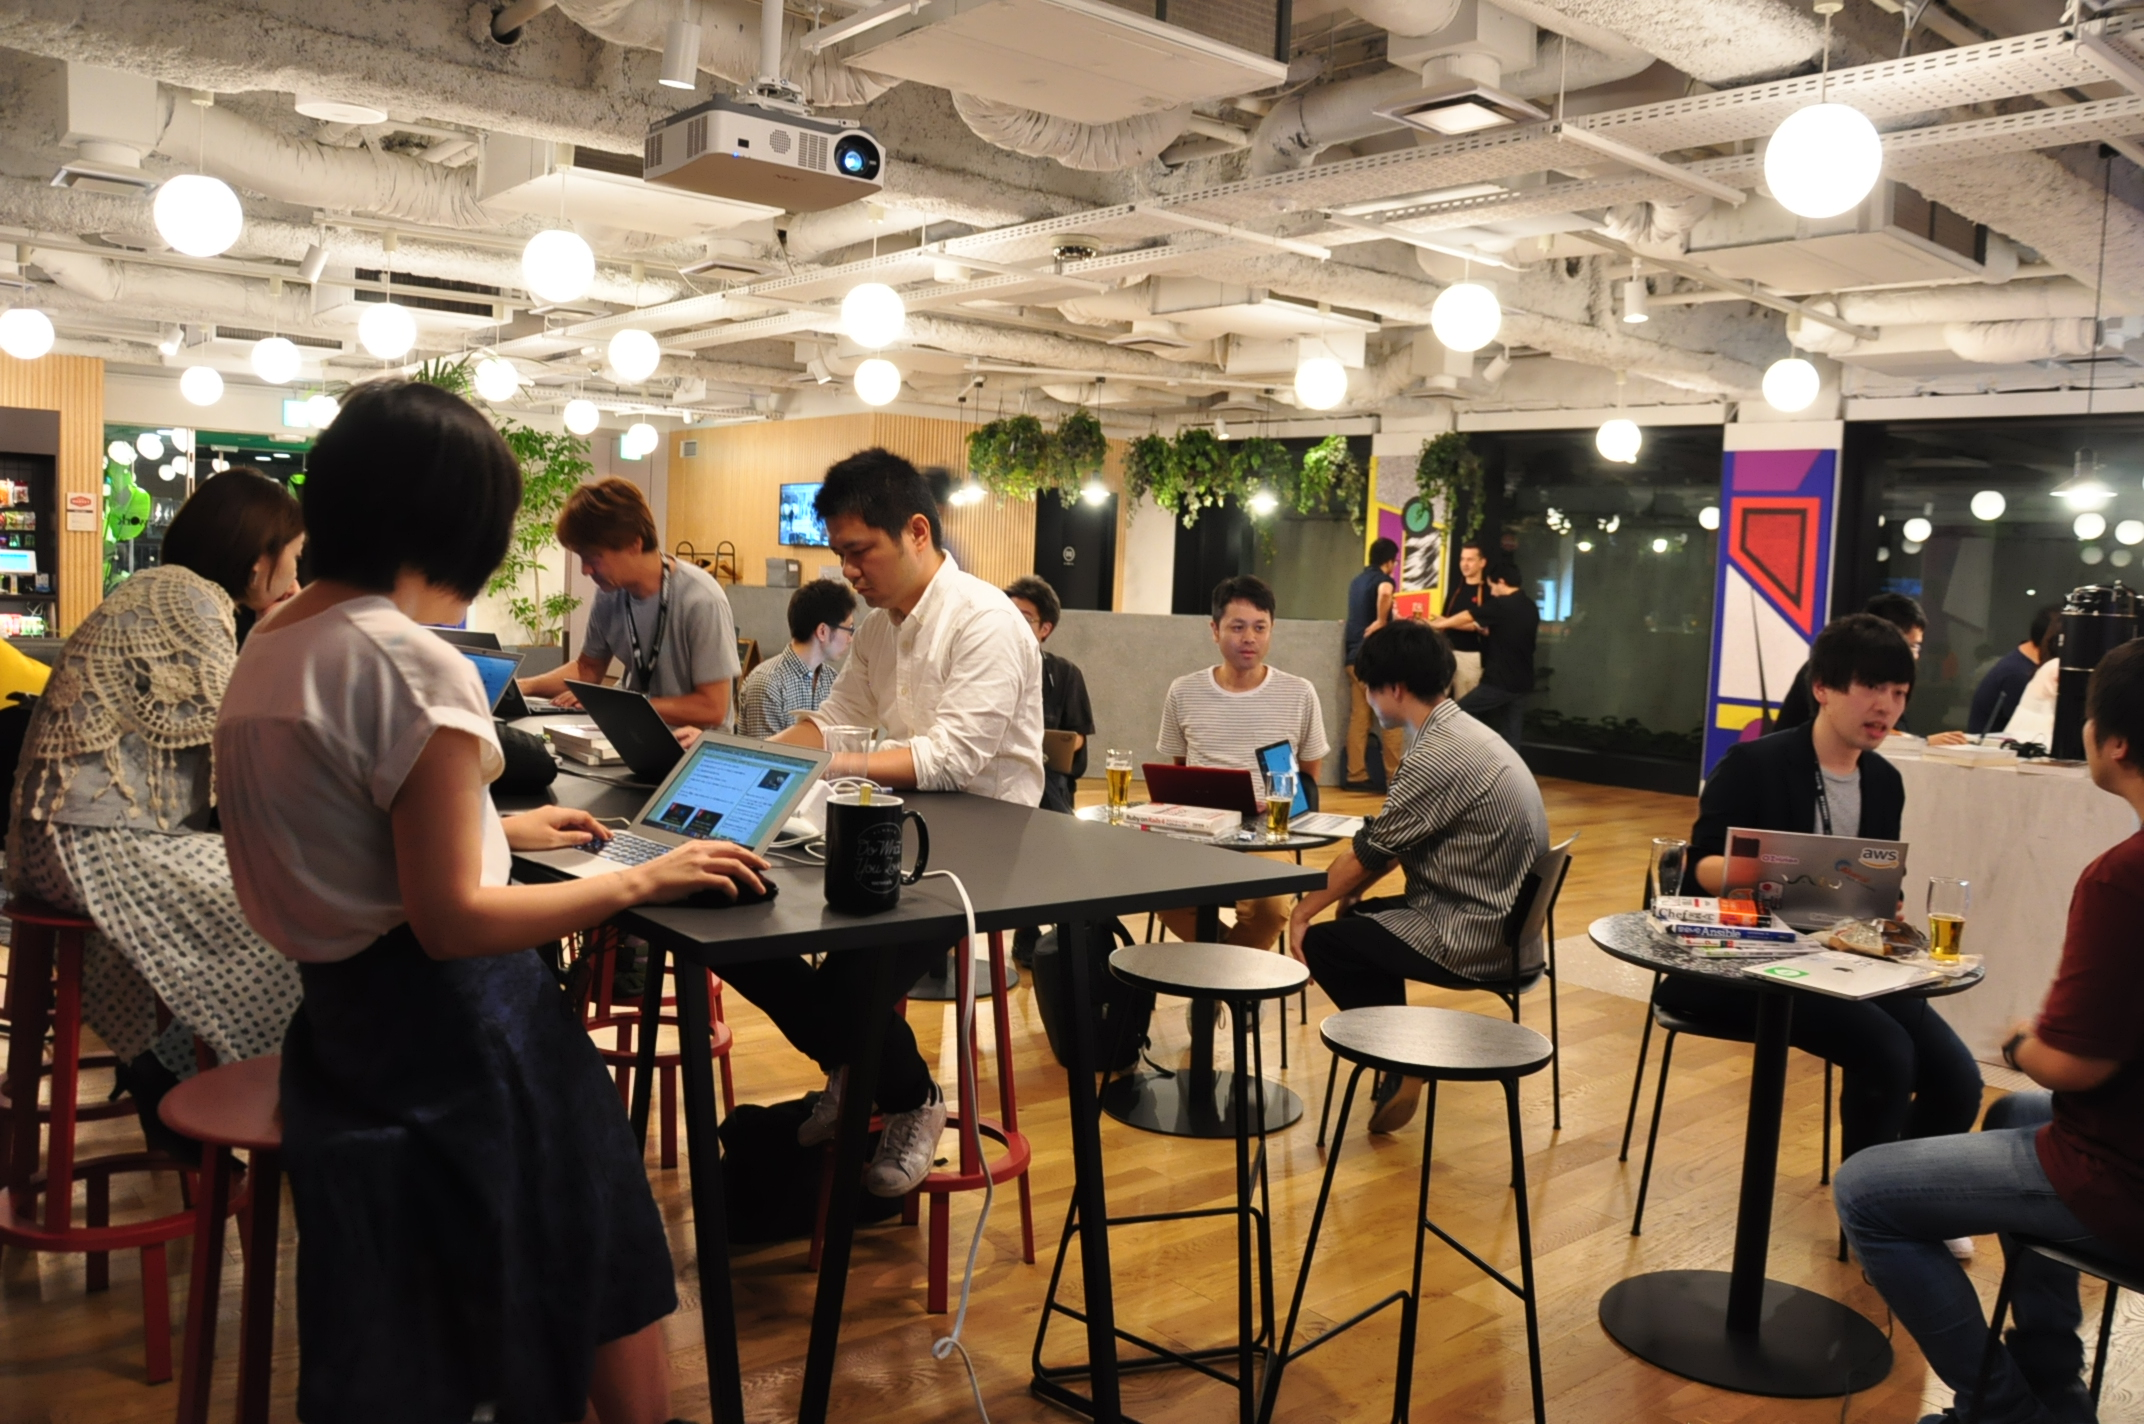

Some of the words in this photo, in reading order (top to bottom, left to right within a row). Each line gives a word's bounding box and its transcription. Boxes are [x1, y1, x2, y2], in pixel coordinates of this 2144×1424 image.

[1126, 814, 1140, 823] Ruby
[1148, 816, 1160, 825] Rails
[857, 839, 878, 856] Do
[1862, 849, 1898, 861] aws
[855, 858, 881, 878] You
[1658, 907, 1690, 921] Chef
[1701, 926, 1742, 938] Ansible
